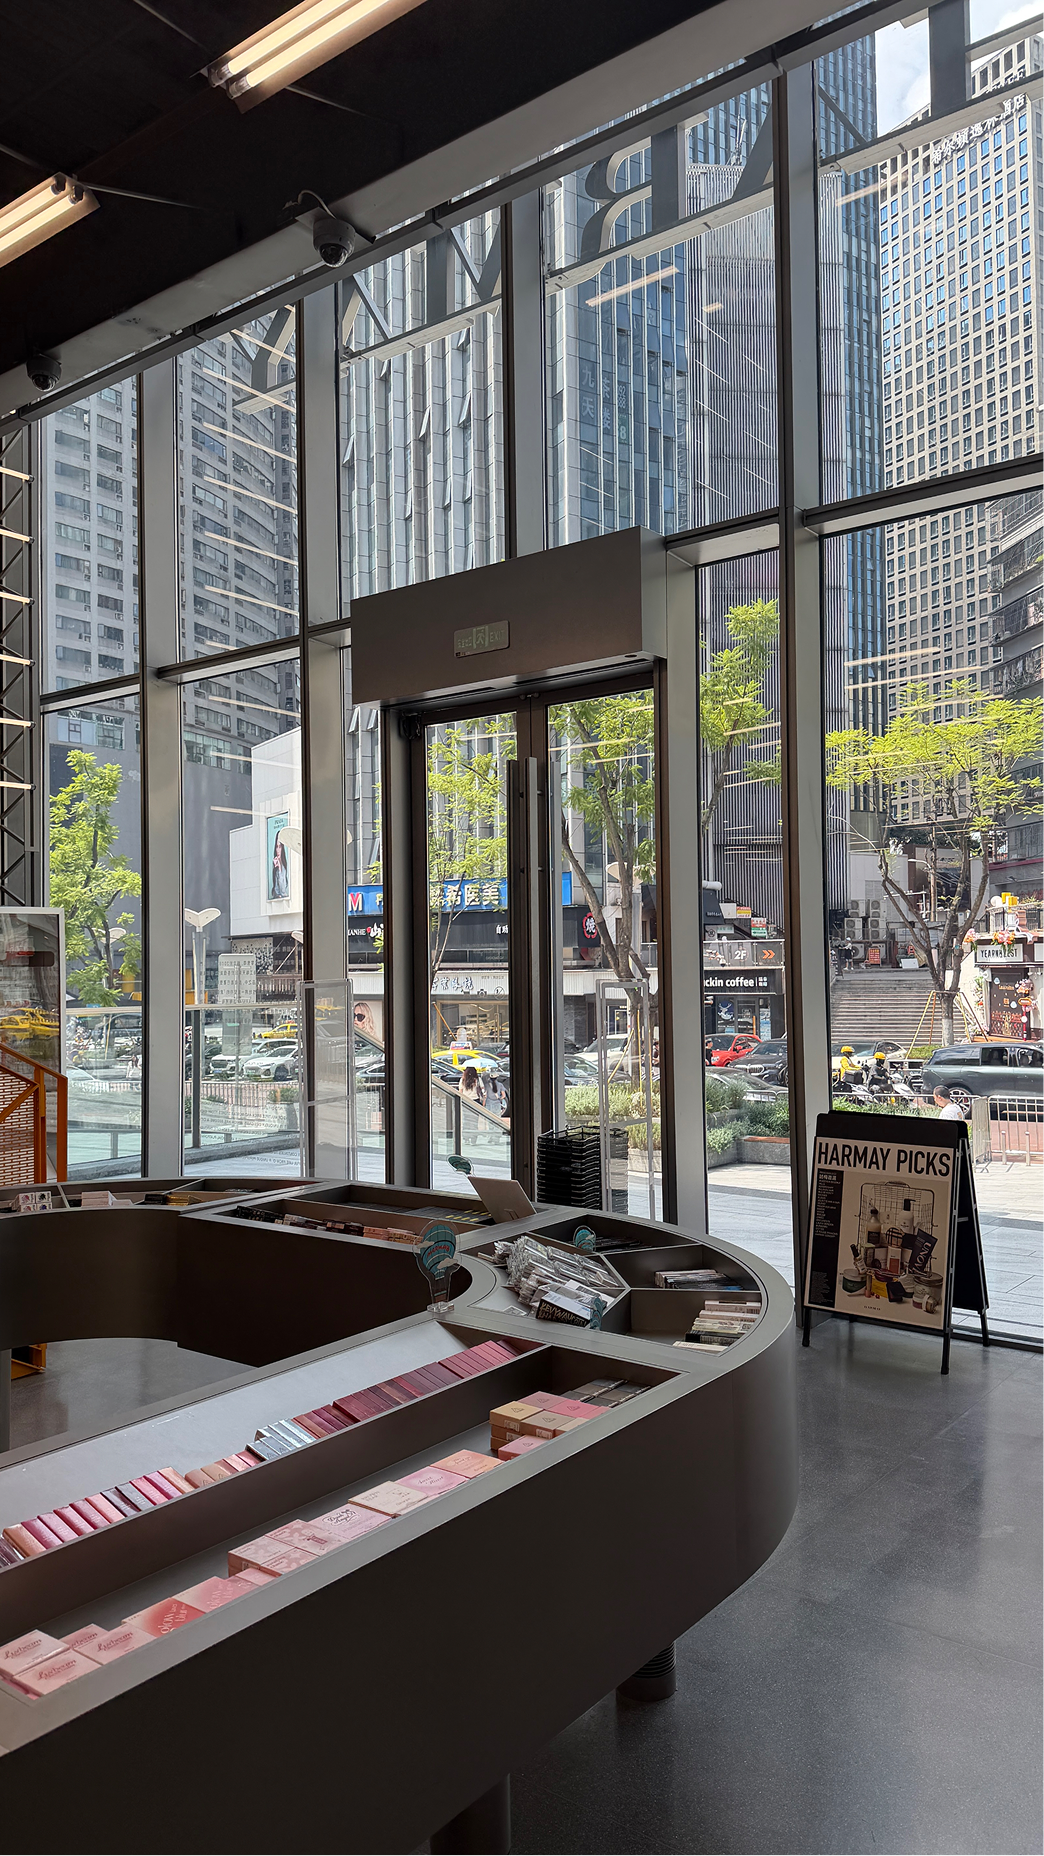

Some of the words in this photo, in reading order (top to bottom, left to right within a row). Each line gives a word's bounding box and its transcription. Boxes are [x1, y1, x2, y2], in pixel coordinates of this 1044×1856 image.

[489, 630, 505, 642] EXIT
[734, 950, 747, 960] 2F
[725, 976, 754, 987] coffee
[818, 1142, 891, 1170] HARMAY
[896, 1149, 951, 1177] PICKS
